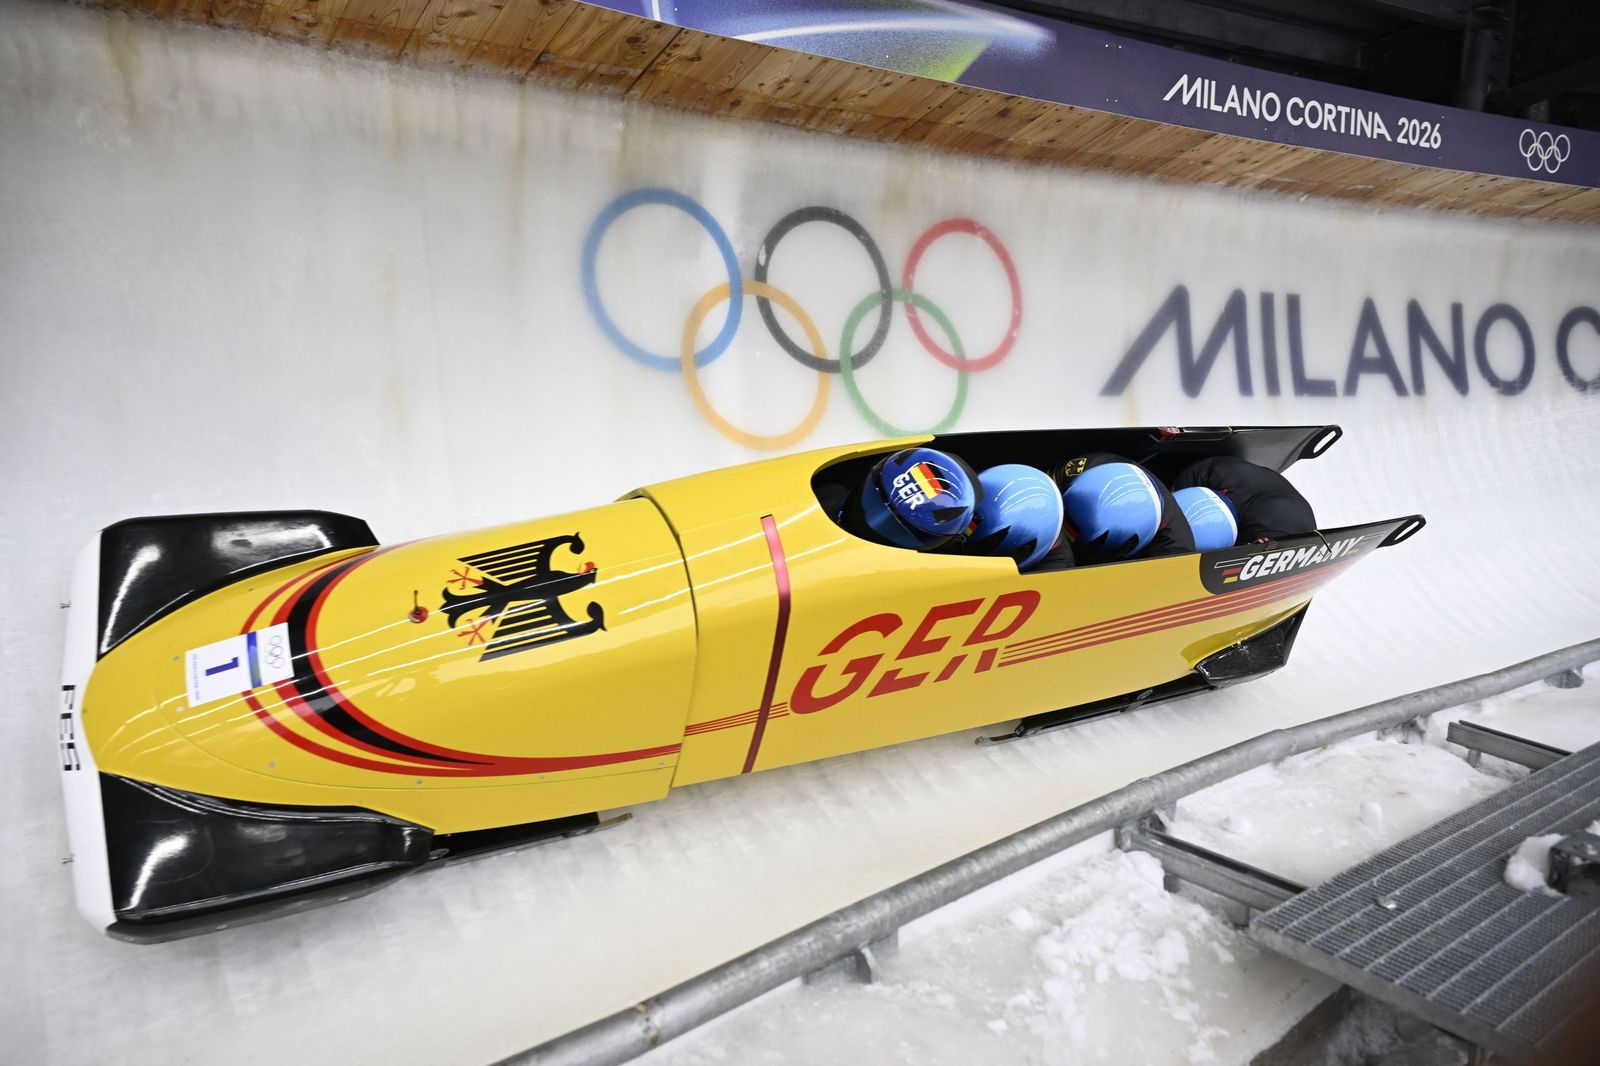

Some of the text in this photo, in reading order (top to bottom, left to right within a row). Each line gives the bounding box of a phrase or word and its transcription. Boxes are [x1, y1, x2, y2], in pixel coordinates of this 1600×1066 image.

[1162, 74, 1442, 149] MILANO CORTINA 2026
[1098, 284, 1536, 398] MILANO
[893, 473, 926, 511] GER
[1239, 535, 1367, 581] GERMANY
[205, 656, 239, 677] 1
[790, 589, 1042, 715] GER
[60, 684, 81, 771] FES
